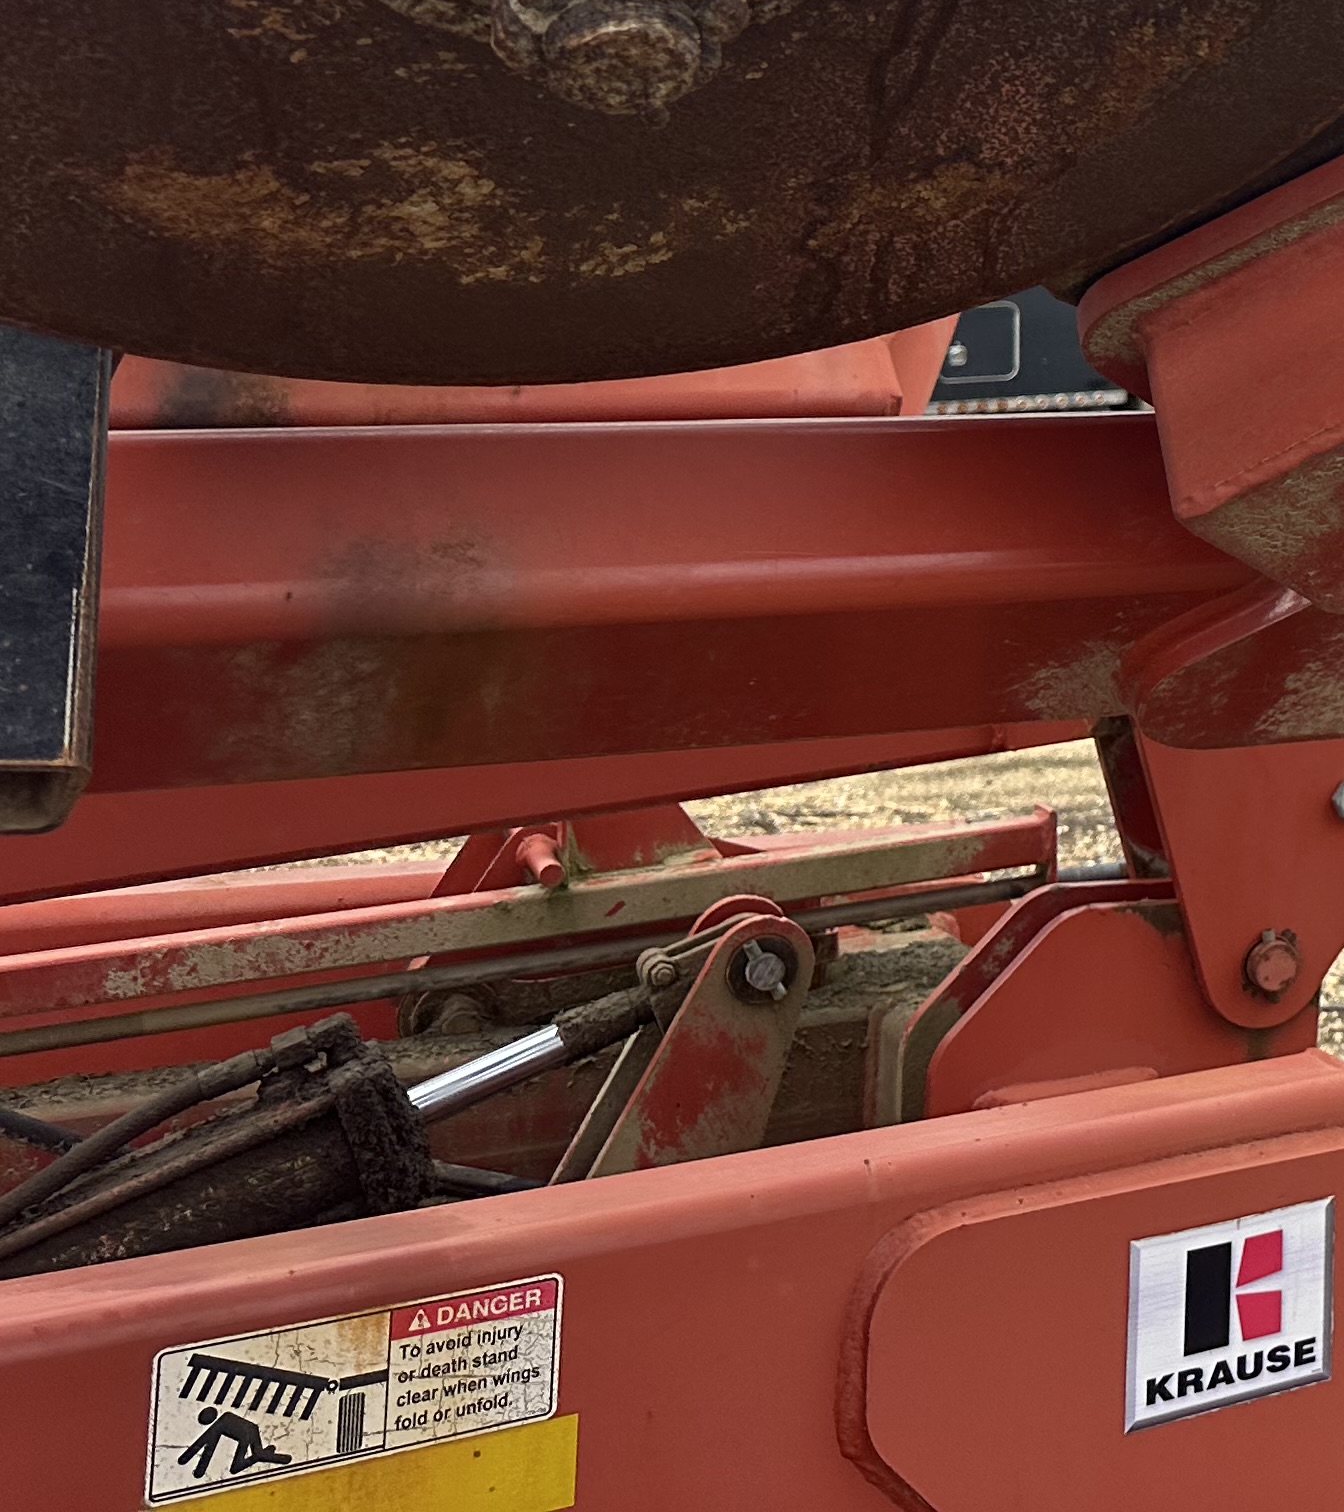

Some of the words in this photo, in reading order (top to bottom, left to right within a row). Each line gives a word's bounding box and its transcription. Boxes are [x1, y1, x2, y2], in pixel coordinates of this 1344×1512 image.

[437, 1288, 542, 1325] DANGER
[399, 1343, 421, 1361] To
[425, 1331, 473, 1356] avoid
[477, 1325, 524, 1346] injury
[397, 1369, 417, 1384] or
[420, 1356, 467, 1380] death
[471, 1345, 519, 1369] stand
[1146, 1336, 1316, 1406] KRAUSE
[396, 1387, 439, 1408] clear
[443, 1377, 488, 1397] when
[492, 1366, 541, 1385] wings
[394, 1409, 428, 1431] fold
[433, 1407, 451, 1422] or
[456, 1392, 513, 1418] unfold.
